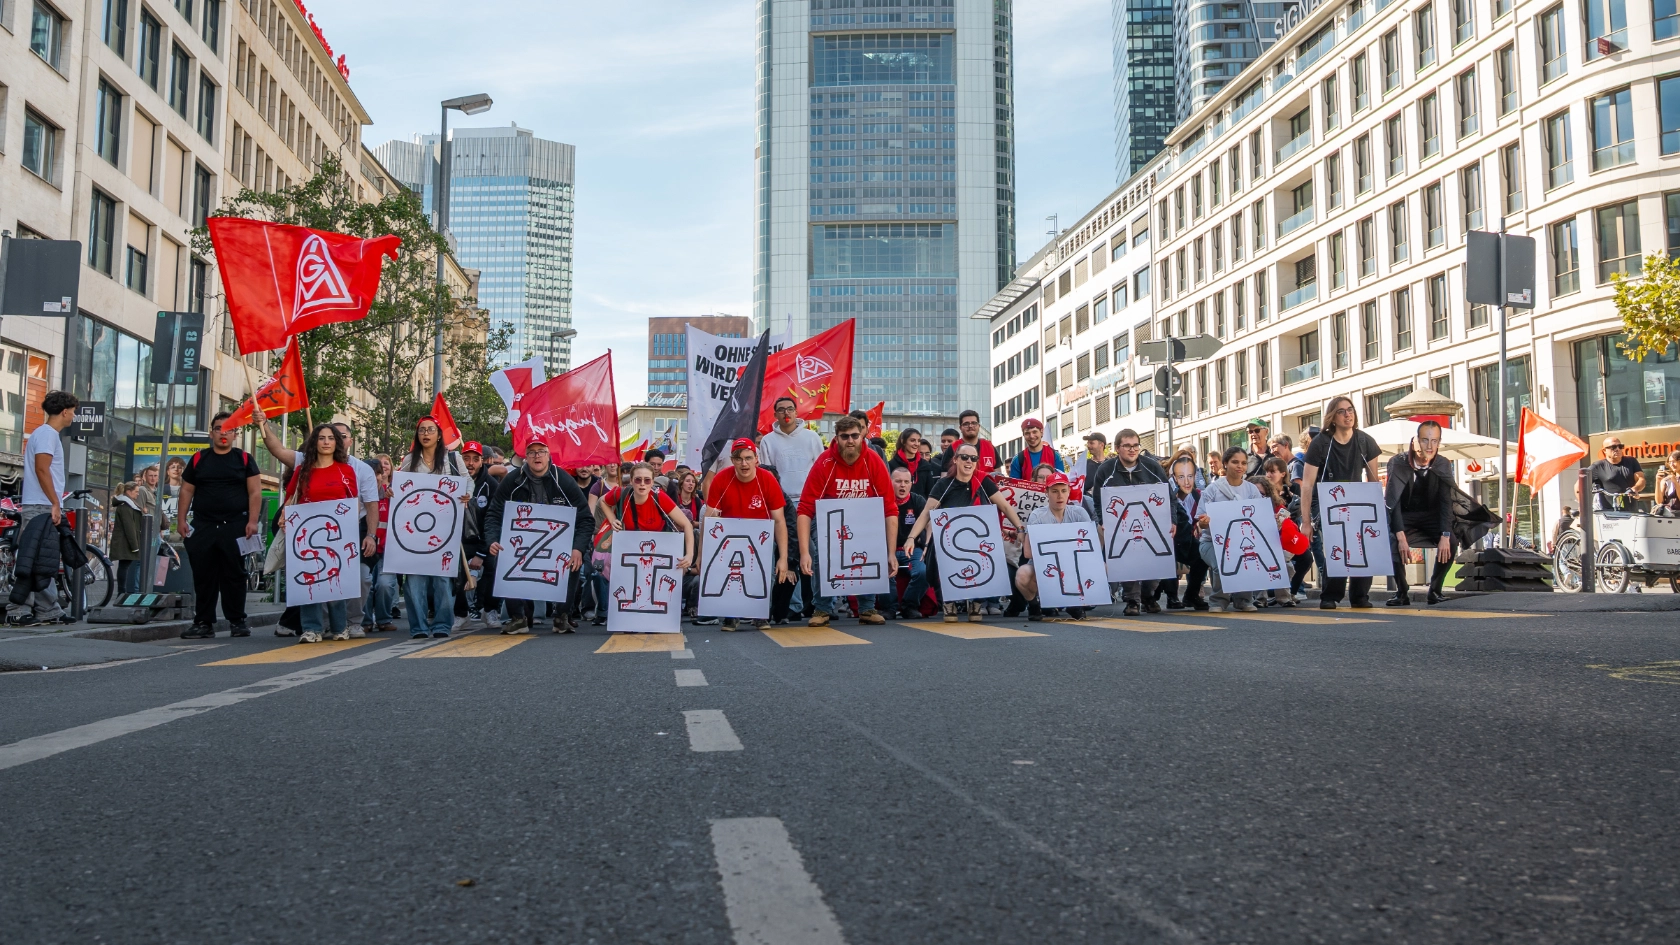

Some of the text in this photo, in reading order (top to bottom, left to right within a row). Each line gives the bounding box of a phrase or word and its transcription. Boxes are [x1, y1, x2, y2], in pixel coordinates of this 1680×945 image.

[183, 331, 197, 369] MS B
[696, 354, 737, 383] WIRD
[714, 344, 751, 363] OHNE
[73, 414, 103, 423] DOORMAN
[1622, 440, 1680, 458] antan
[835, 478, 870, 490] TARIF
[293, 514, 342, 586] S
[392, 488, 457, 554] O
[827, 509, 880, 582] L
[1108, 501, 1172, 559] A
[1221, 518, 1281, 576] A
[1327, 503, 1377, 568] T
[503, 518, 570, 586] Z
[701, 535, 767, 599] A
[940, 514, 995, 588] S
[1037, 538, 1094, 596] T
[618, 552, 673, 614] I
